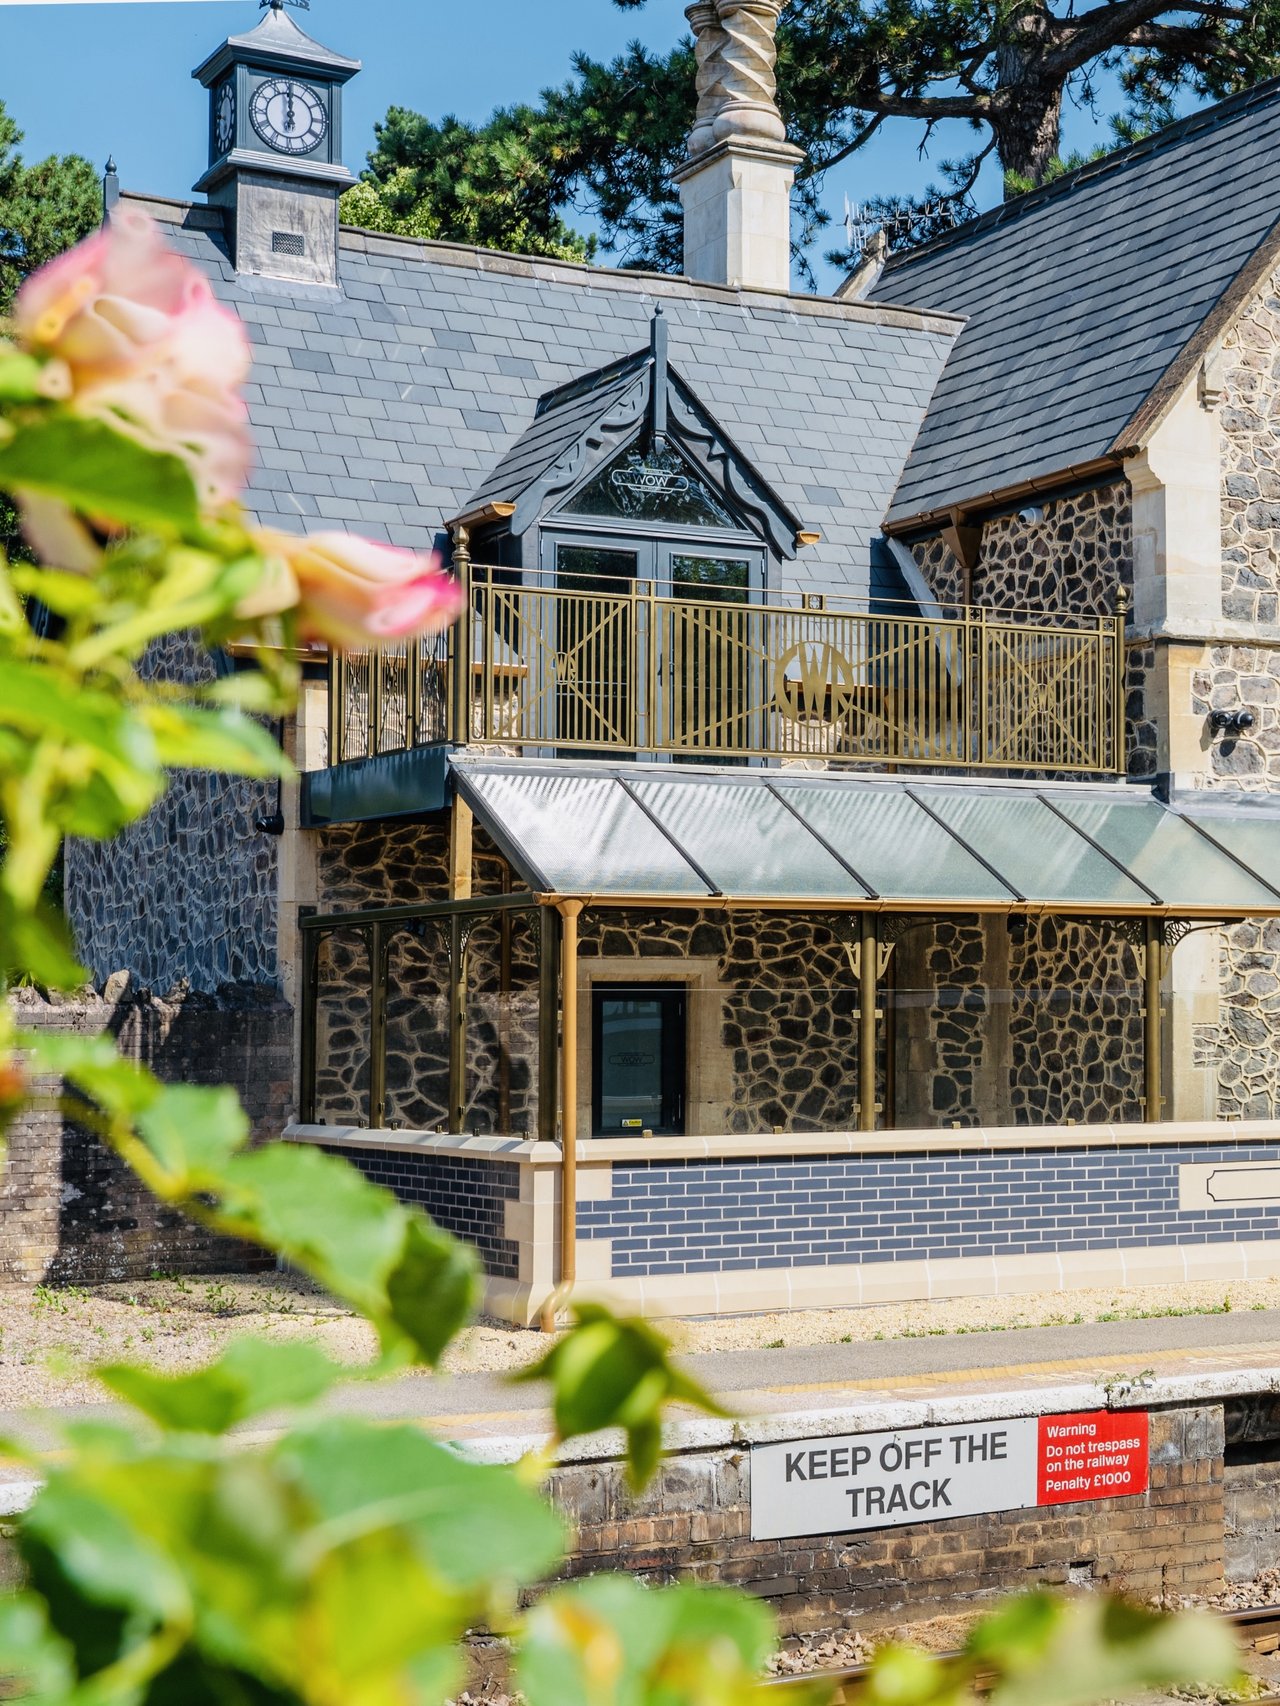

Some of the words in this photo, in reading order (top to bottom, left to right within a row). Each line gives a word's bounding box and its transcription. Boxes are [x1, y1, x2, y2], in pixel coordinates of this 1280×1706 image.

[633, 474, 669, 487] WOW
[774, 641, 855, 728] GWR
[1046, 1423, 1097, 1438] Warning
[785, 1445, 872, 1483] KEEP
[879, 1437, 943, 1473] OFF
[949, 1431, 1008, 1464] THE
[1046, 1445, 1063, 1457] Do
[1065, 1441, 1086, 1455] not
[1088, 1438, 1141, 1453] trespass
[1046, 1461, 1062, 1473] on
[1064, 1458, 1084, 1471] the
[1087, 1454, 1130, 1469] railway
[1046, 1477, 1091, 1492] Penalty
[1094, 1471, 1131, 1487] £1000
[845, 1477, 952, 1518] TRACK
